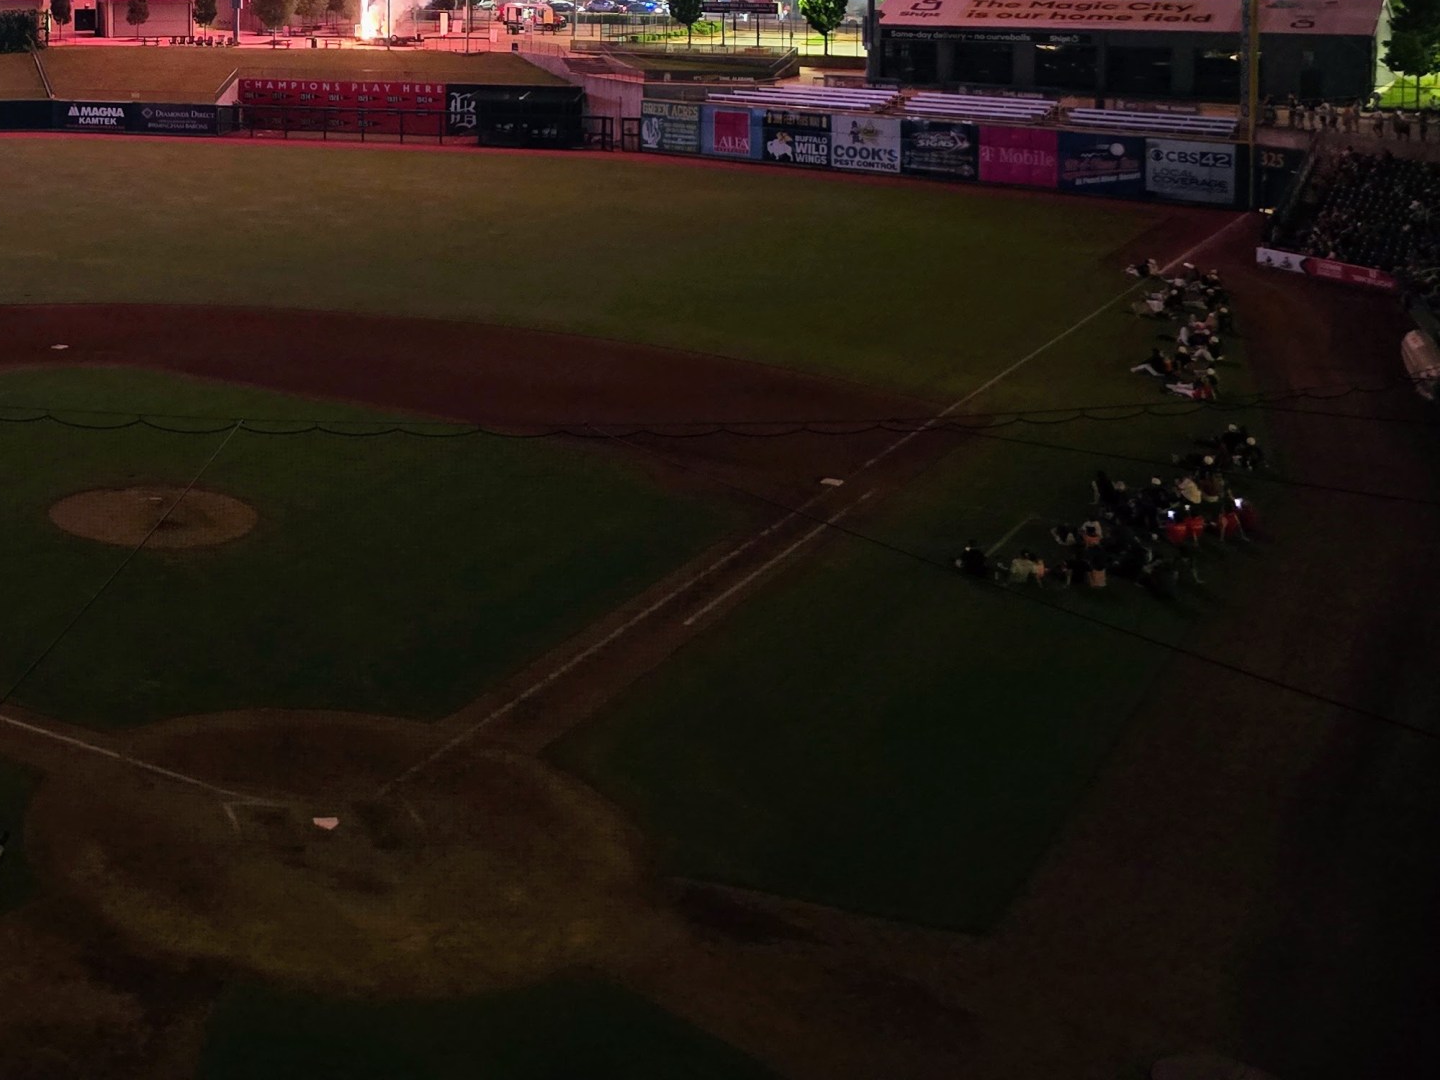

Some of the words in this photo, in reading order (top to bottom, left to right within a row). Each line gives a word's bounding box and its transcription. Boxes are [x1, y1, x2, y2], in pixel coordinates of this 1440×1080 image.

[972, 0, 1020, 9] The
[1029, 0, 1122, 13] Magic
[1127, 1, 1191, 13] City
[965, 10, 979, 18] is
[983, 11, 1041, 20] our
[1048, 11, 1130, 22] home
[1142, 13, 1209, 23] field
[890, 31, 931, 40] Same-day
[933, 32, 966, 42] delivery
[985, 33, 1029, 42] curveballs
[244, 80, 340, 92] CHAMPIONS
[351, 82, 391, 93] PLAY
[403, 84, 444, 94] HERE
[80, 106, 125, 118] MAGNA
[642, 103, 669, 116] GREEN
[671, 104, 699, 118] ACRES
[78, 117, 117, 125] KAMTEK
[719, 136, 749, 150] ALFA
[794, 135, 827, 144] BUFFALO
[916, 139, 954, 148] SIGNS
[794, 142, 828, 155] WILD
[834, 144, 898, 163] COOK'S
[795, 154, 828, 164] WINGS
[999, 147, 1055, 167] Mobile
[1165, 151, 1199, 164] CBS
[1200, 152, 1230, 168] 42
[1260, 151, 1285, 168] 325
[834, 158, 854, 167] PEST
[856, 160, 898, 170] CONTROL
[1152, 167, 1192, 177] LOCAL
[1152, 175, 1227, 189] COVERAGE
